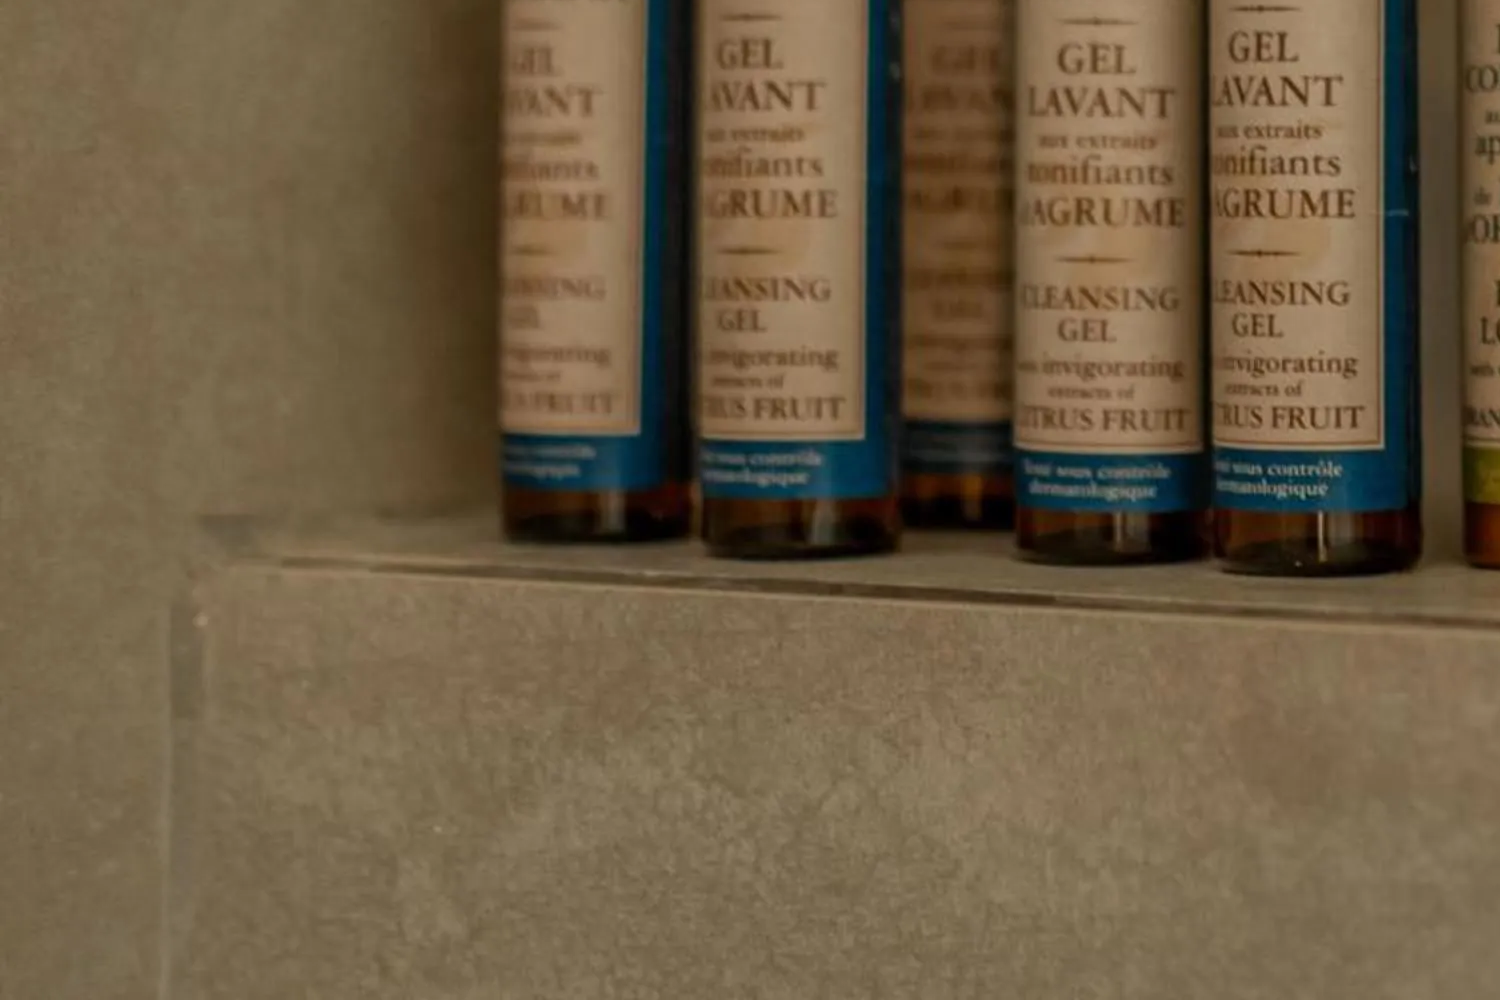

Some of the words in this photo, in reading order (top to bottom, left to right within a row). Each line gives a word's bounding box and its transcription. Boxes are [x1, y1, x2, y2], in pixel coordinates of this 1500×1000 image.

[716, 37, 784, 71] GEL
[1056, 41, 1137, 76] GEL
[1227, 30, 1300, 65] GEL
[1028, 84, 1176, 120] LAVANT
[1243, 119, 1324, 140] extraits
[717, 308, 768, 333] GEL
[1057, 318, 1118, 344] GEL
[1231, 312, 1285, 339] GEL
[1284, 379, 1304, 398] of
[752, 397, 847, 422] FRUIT
[1102, 406, 1193, 433] FRUIT
[1271, 404, 1366, 431] FRUIT
